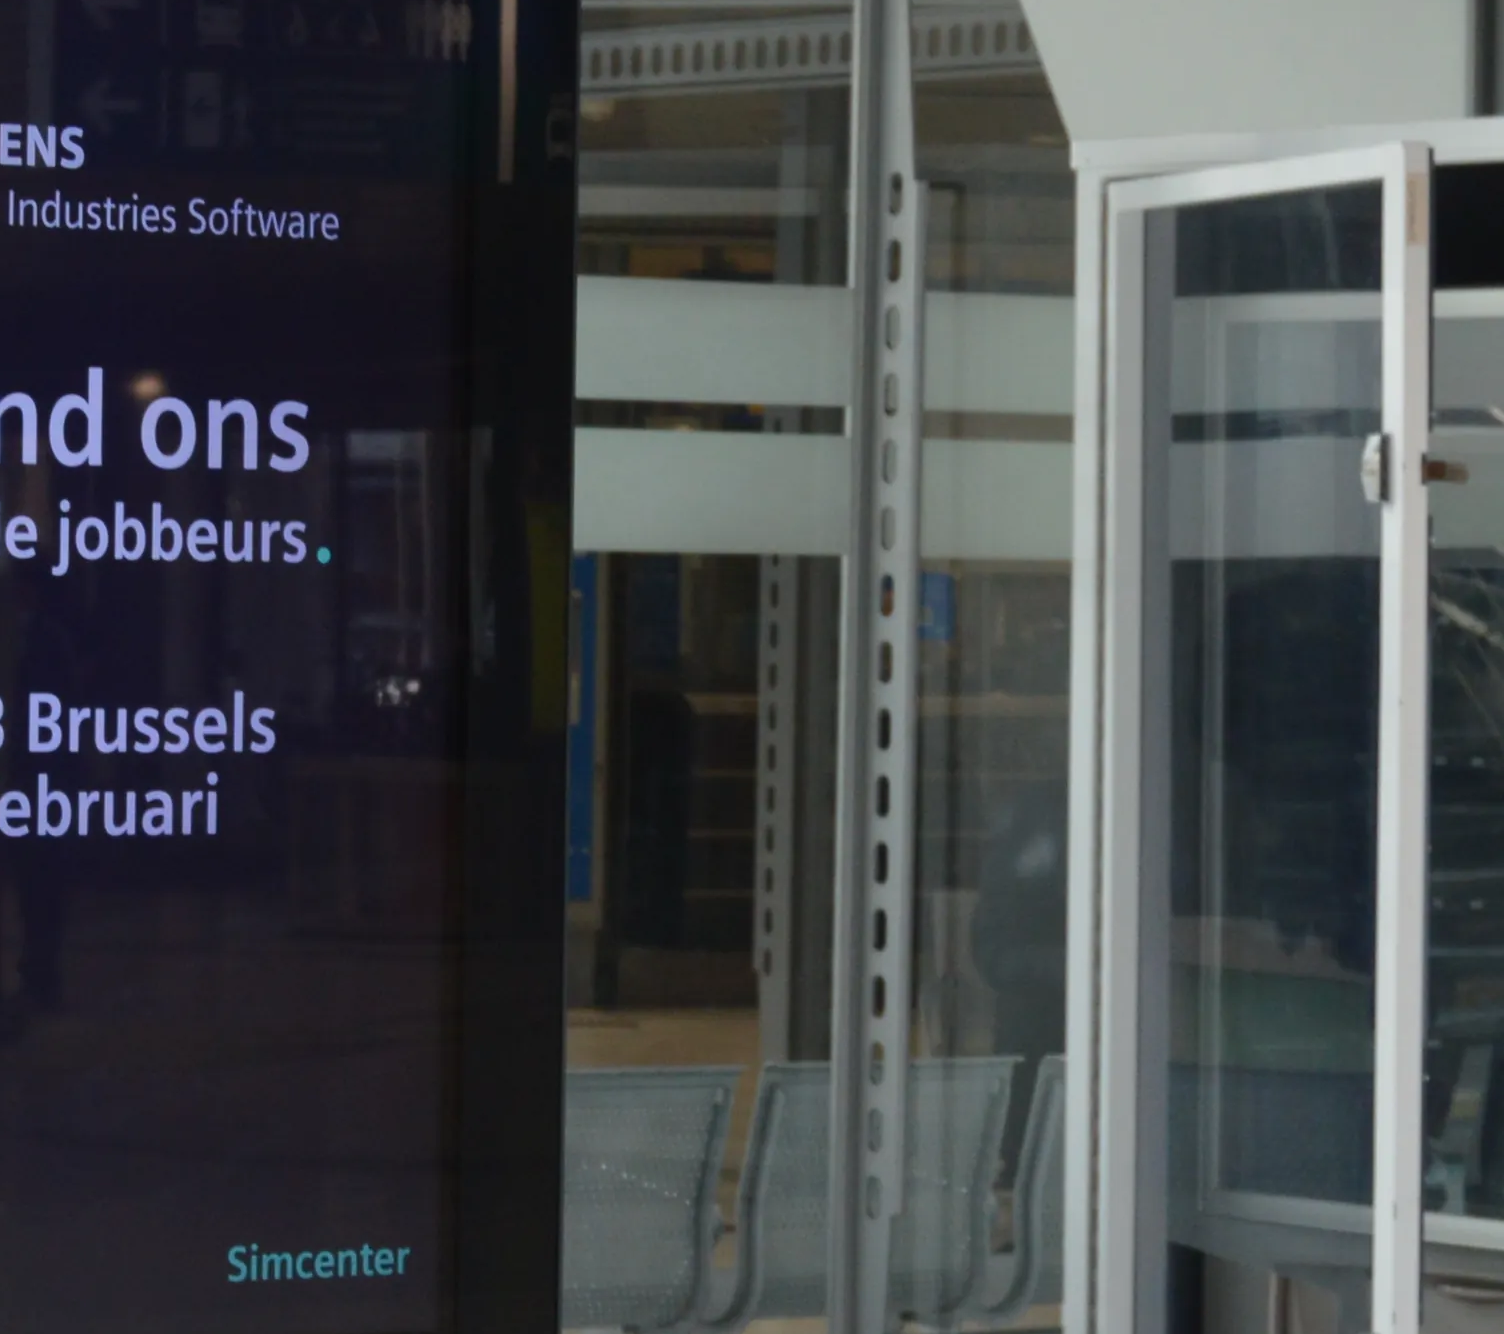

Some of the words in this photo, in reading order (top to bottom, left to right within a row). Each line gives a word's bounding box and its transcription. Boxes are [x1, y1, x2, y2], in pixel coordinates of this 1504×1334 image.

[7, 189, 178, 236] Industries
[188, 197, 341, 241] Software
[140, 395, 311, 472] ons
[51, 501, 332, 576] jobbeurs.
[27, 690, 277, 755] Brussels
[226, 1242, 411, 1283] Simcenter
